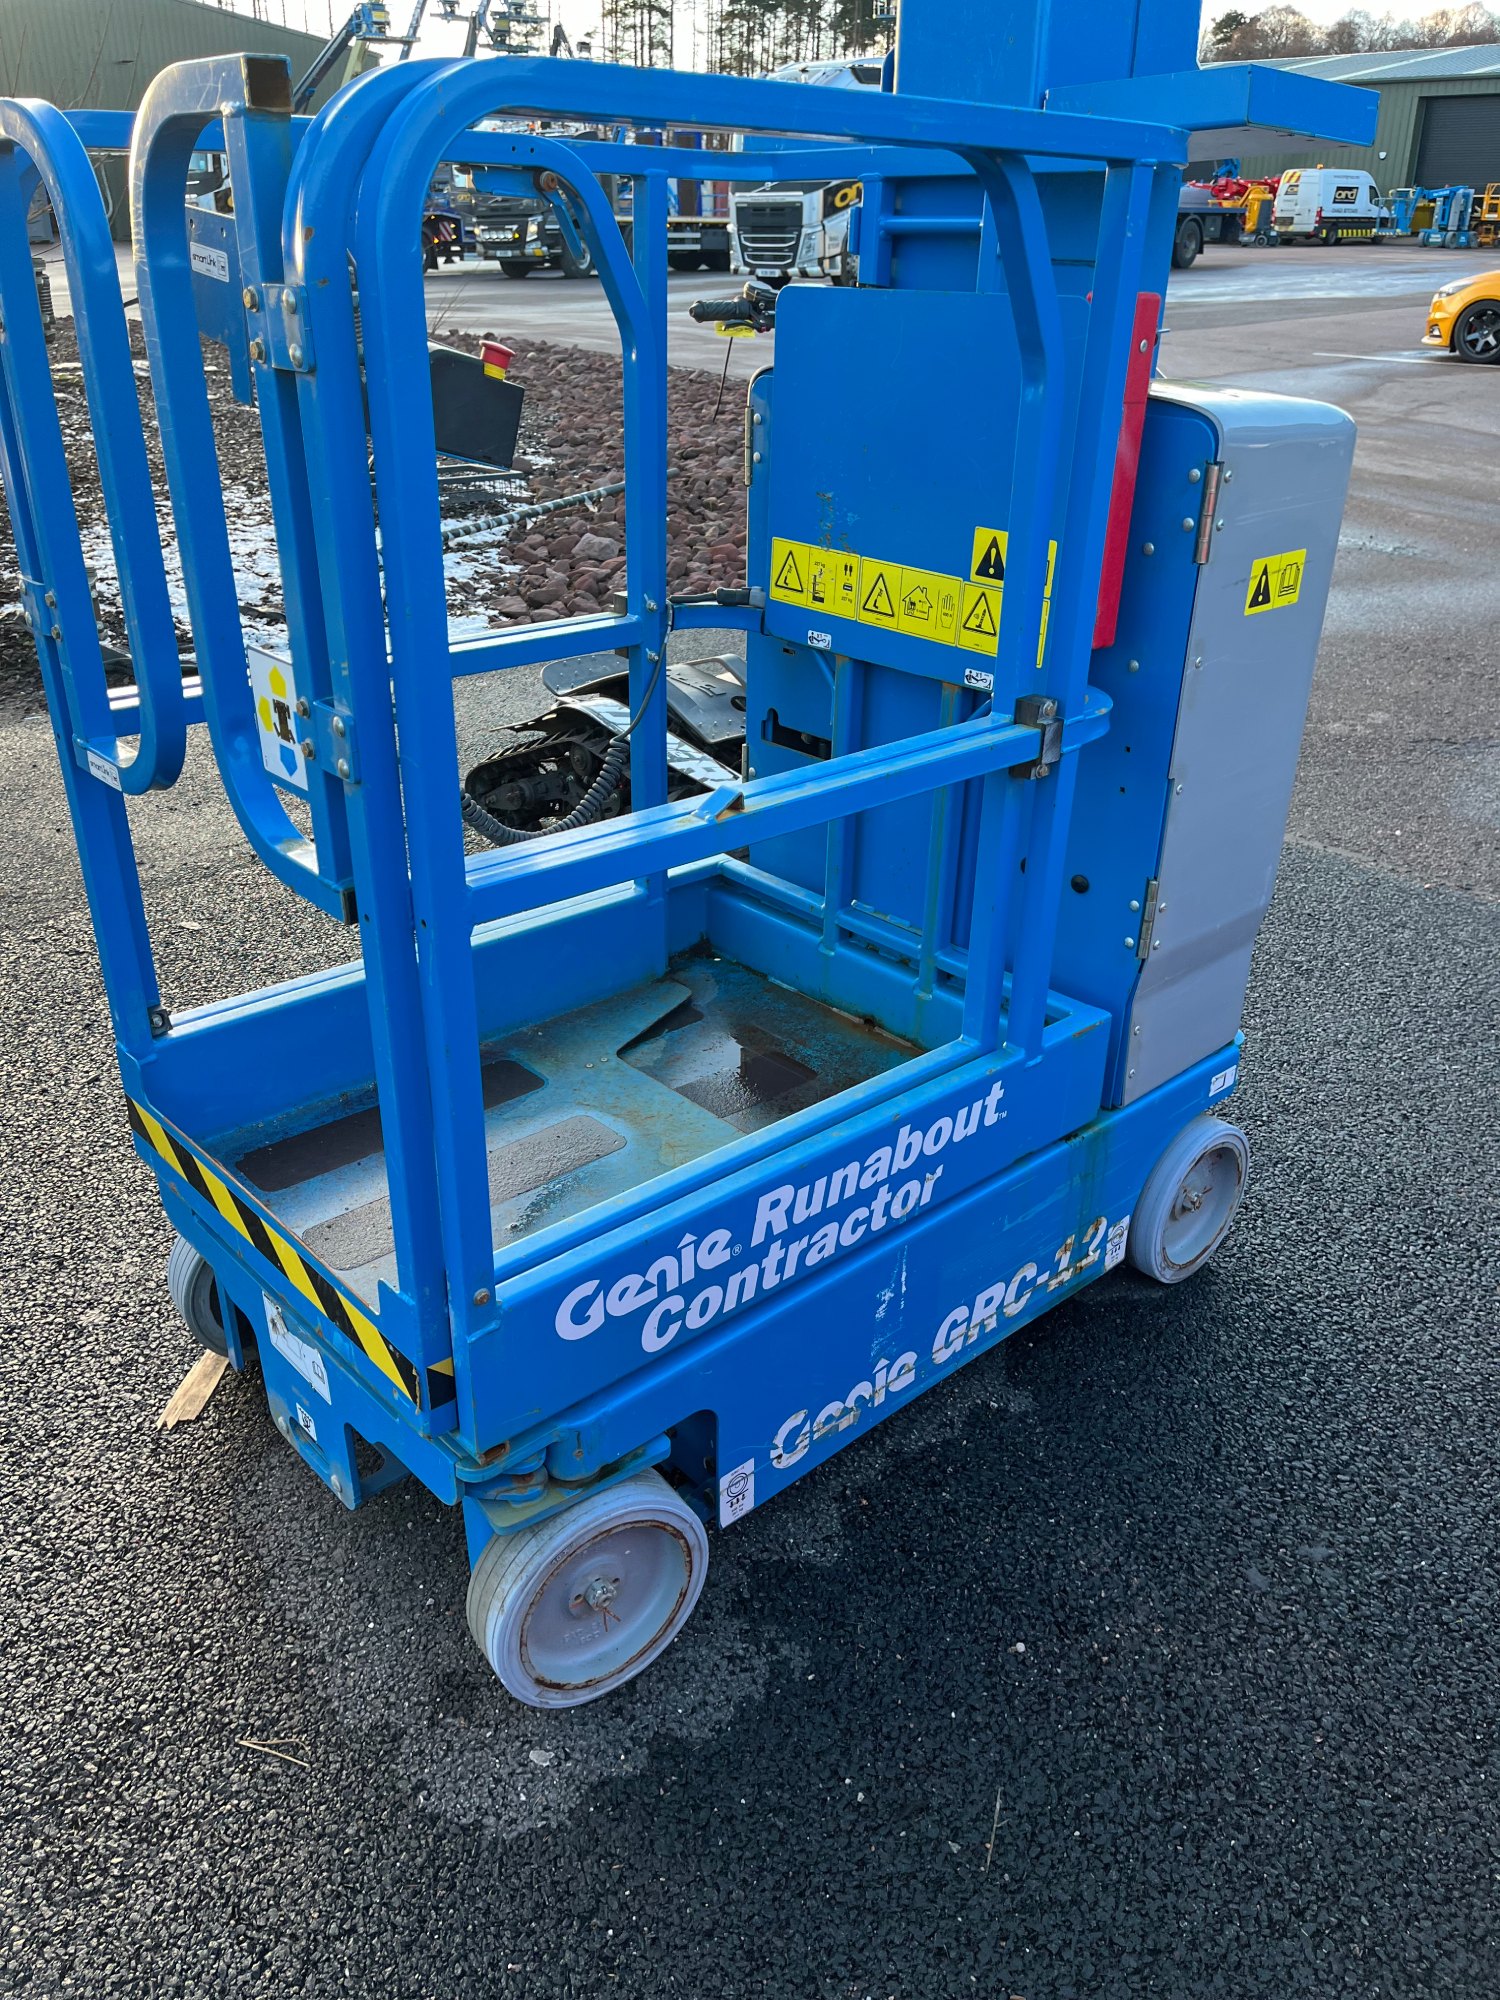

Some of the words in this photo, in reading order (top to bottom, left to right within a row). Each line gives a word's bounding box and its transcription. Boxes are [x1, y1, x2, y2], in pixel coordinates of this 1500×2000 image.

[834, 182, 862, 208] or
[1335, 188, 1358, 200] ord
[641, 1164, 944, 1353] Contractor
[932, 1216, 1108, 1365] GRC-12
